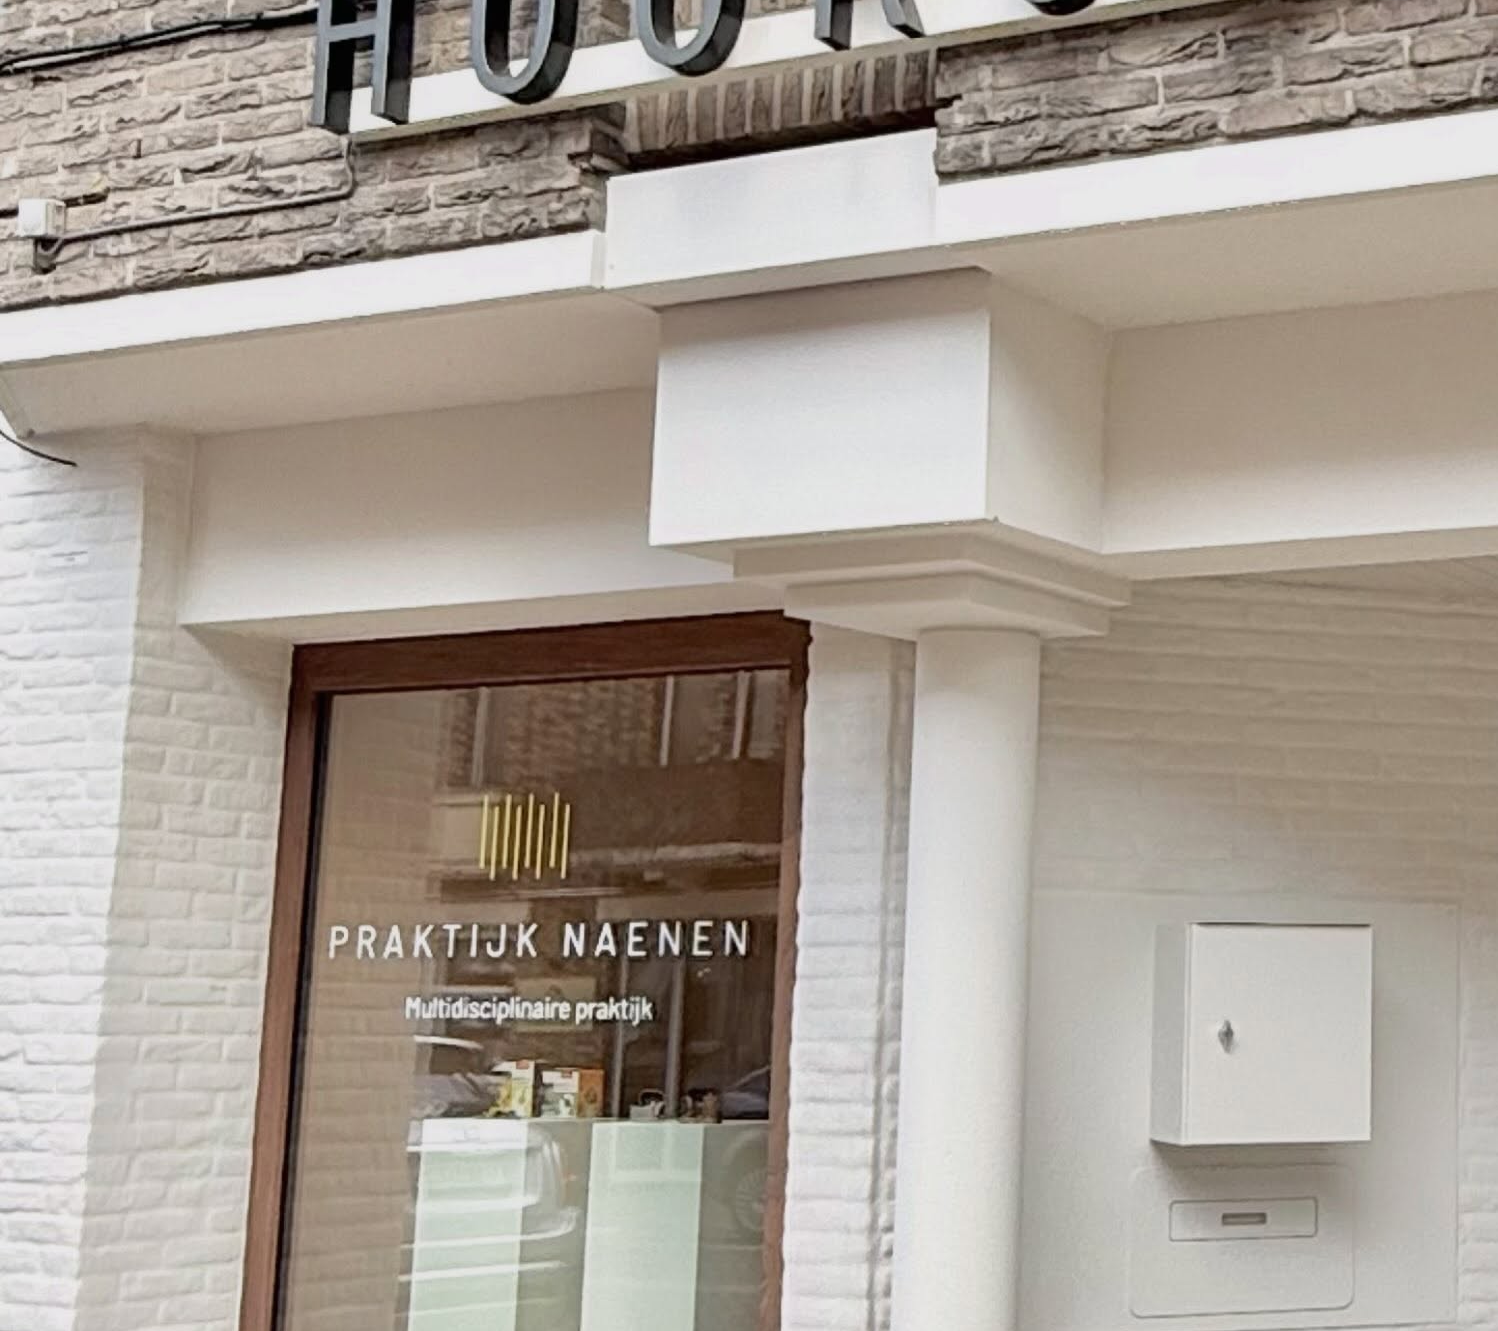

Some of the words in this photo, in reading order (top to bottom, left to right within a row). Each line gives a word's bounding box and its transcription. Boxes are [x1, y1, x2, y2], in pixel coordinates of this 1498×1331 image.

[328, 922, 538, 959] PRAKTIJK
[562, 920, 749, 957] NAENEN
[405, 996, 571, 1025] Multidisciplinaire
[575, 997, 653, 1027] praktijk
